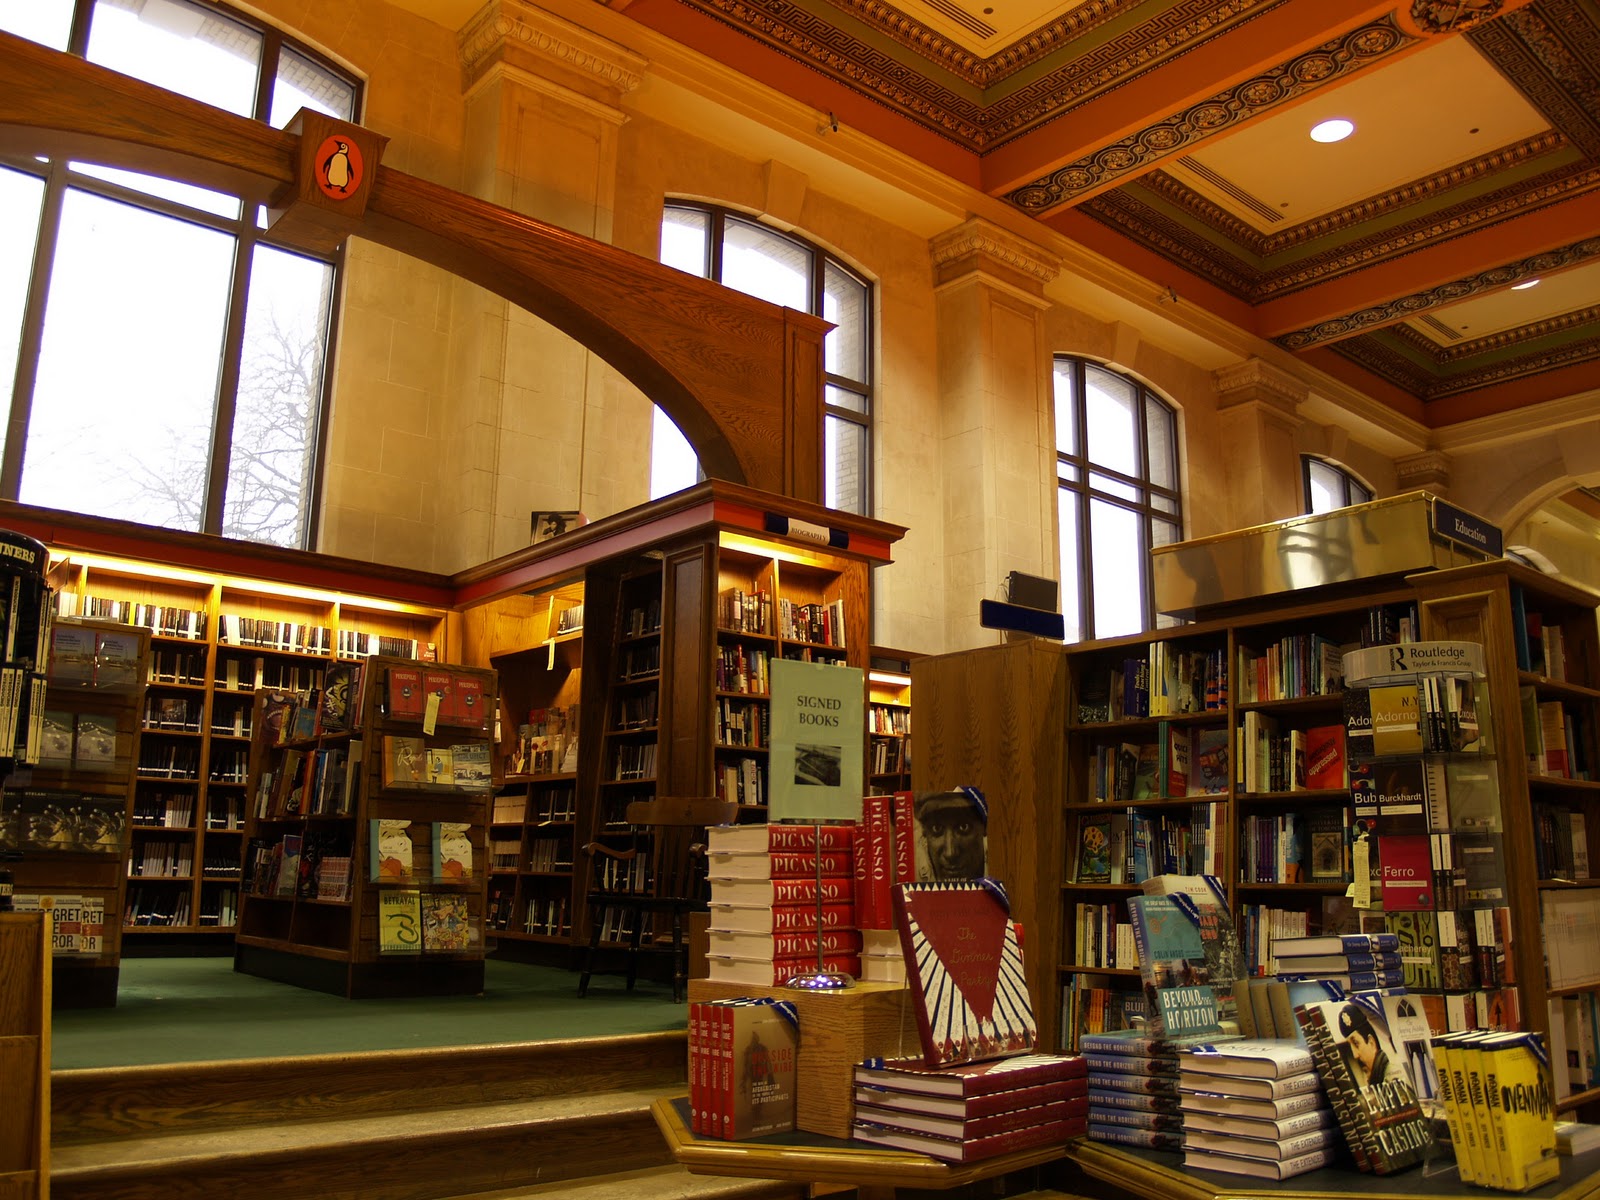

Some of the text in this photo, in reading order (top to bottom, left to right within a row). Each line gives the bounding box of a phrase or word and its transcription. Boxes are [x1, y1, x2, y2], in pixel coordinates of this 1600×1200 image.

[791, 527, 826, 541] BIOGRAPHY
[1455, 518, 1487, 544] Education
[0, 542, 35, 564] NERS
[1410, 646, 1465, 660] Routledge
[797, 695, 841, 710] SIGNED
[799, 713, 839, 727] BOOKS
[1375, 710, 1417, 723] Adorno
[1308, 748, 1338, 776] oppressed
[1354, 792, 1377, 804] Bub
[1379, 792, 1422, 803] Burckhardt
[872, 801, 884, 880] PICASSO
[896, 796, 908, 876] PICASSO
[1384, 866, 1415, 877] Ferro
[777, 884, 838, 900] PICASSO
[383, 896, 416, 906] BETRAYAL
[776, 911, 838, 928] PICASSO
[777, 935, 837, 954] PICASSO
[1399, 944, 1432, 955] acherey
[949, 948, 994, 963] Dinner
[1162, 988, 1202, 1009] BEYOND
[1167, 1007, 1216, 1030] HORIZON
[1087, 1059, 1102, 1067] EYOND
[1285, 1058, 1294, 1069] THE
[1283, 1078, 1317, 1091] THE EXTENDED
[1301, 1023, 1364, 1154] EMPTY CASING
[1315, 1023, 1380, 1156] EMPTY CASING
[1286, 1096, 1318, 1111] THE EXTENDED
[1359, 1078, 1414, 1115] EMPTY
[1288, 1116, 1321, 1130] THE EXTENDED
[1290, 1136, 1324, 1150] THE EXTENDED
[1378, 1118, 1430, 1157] CASING
[1290, 1155, 1323, 1169] THE EXTENDED
